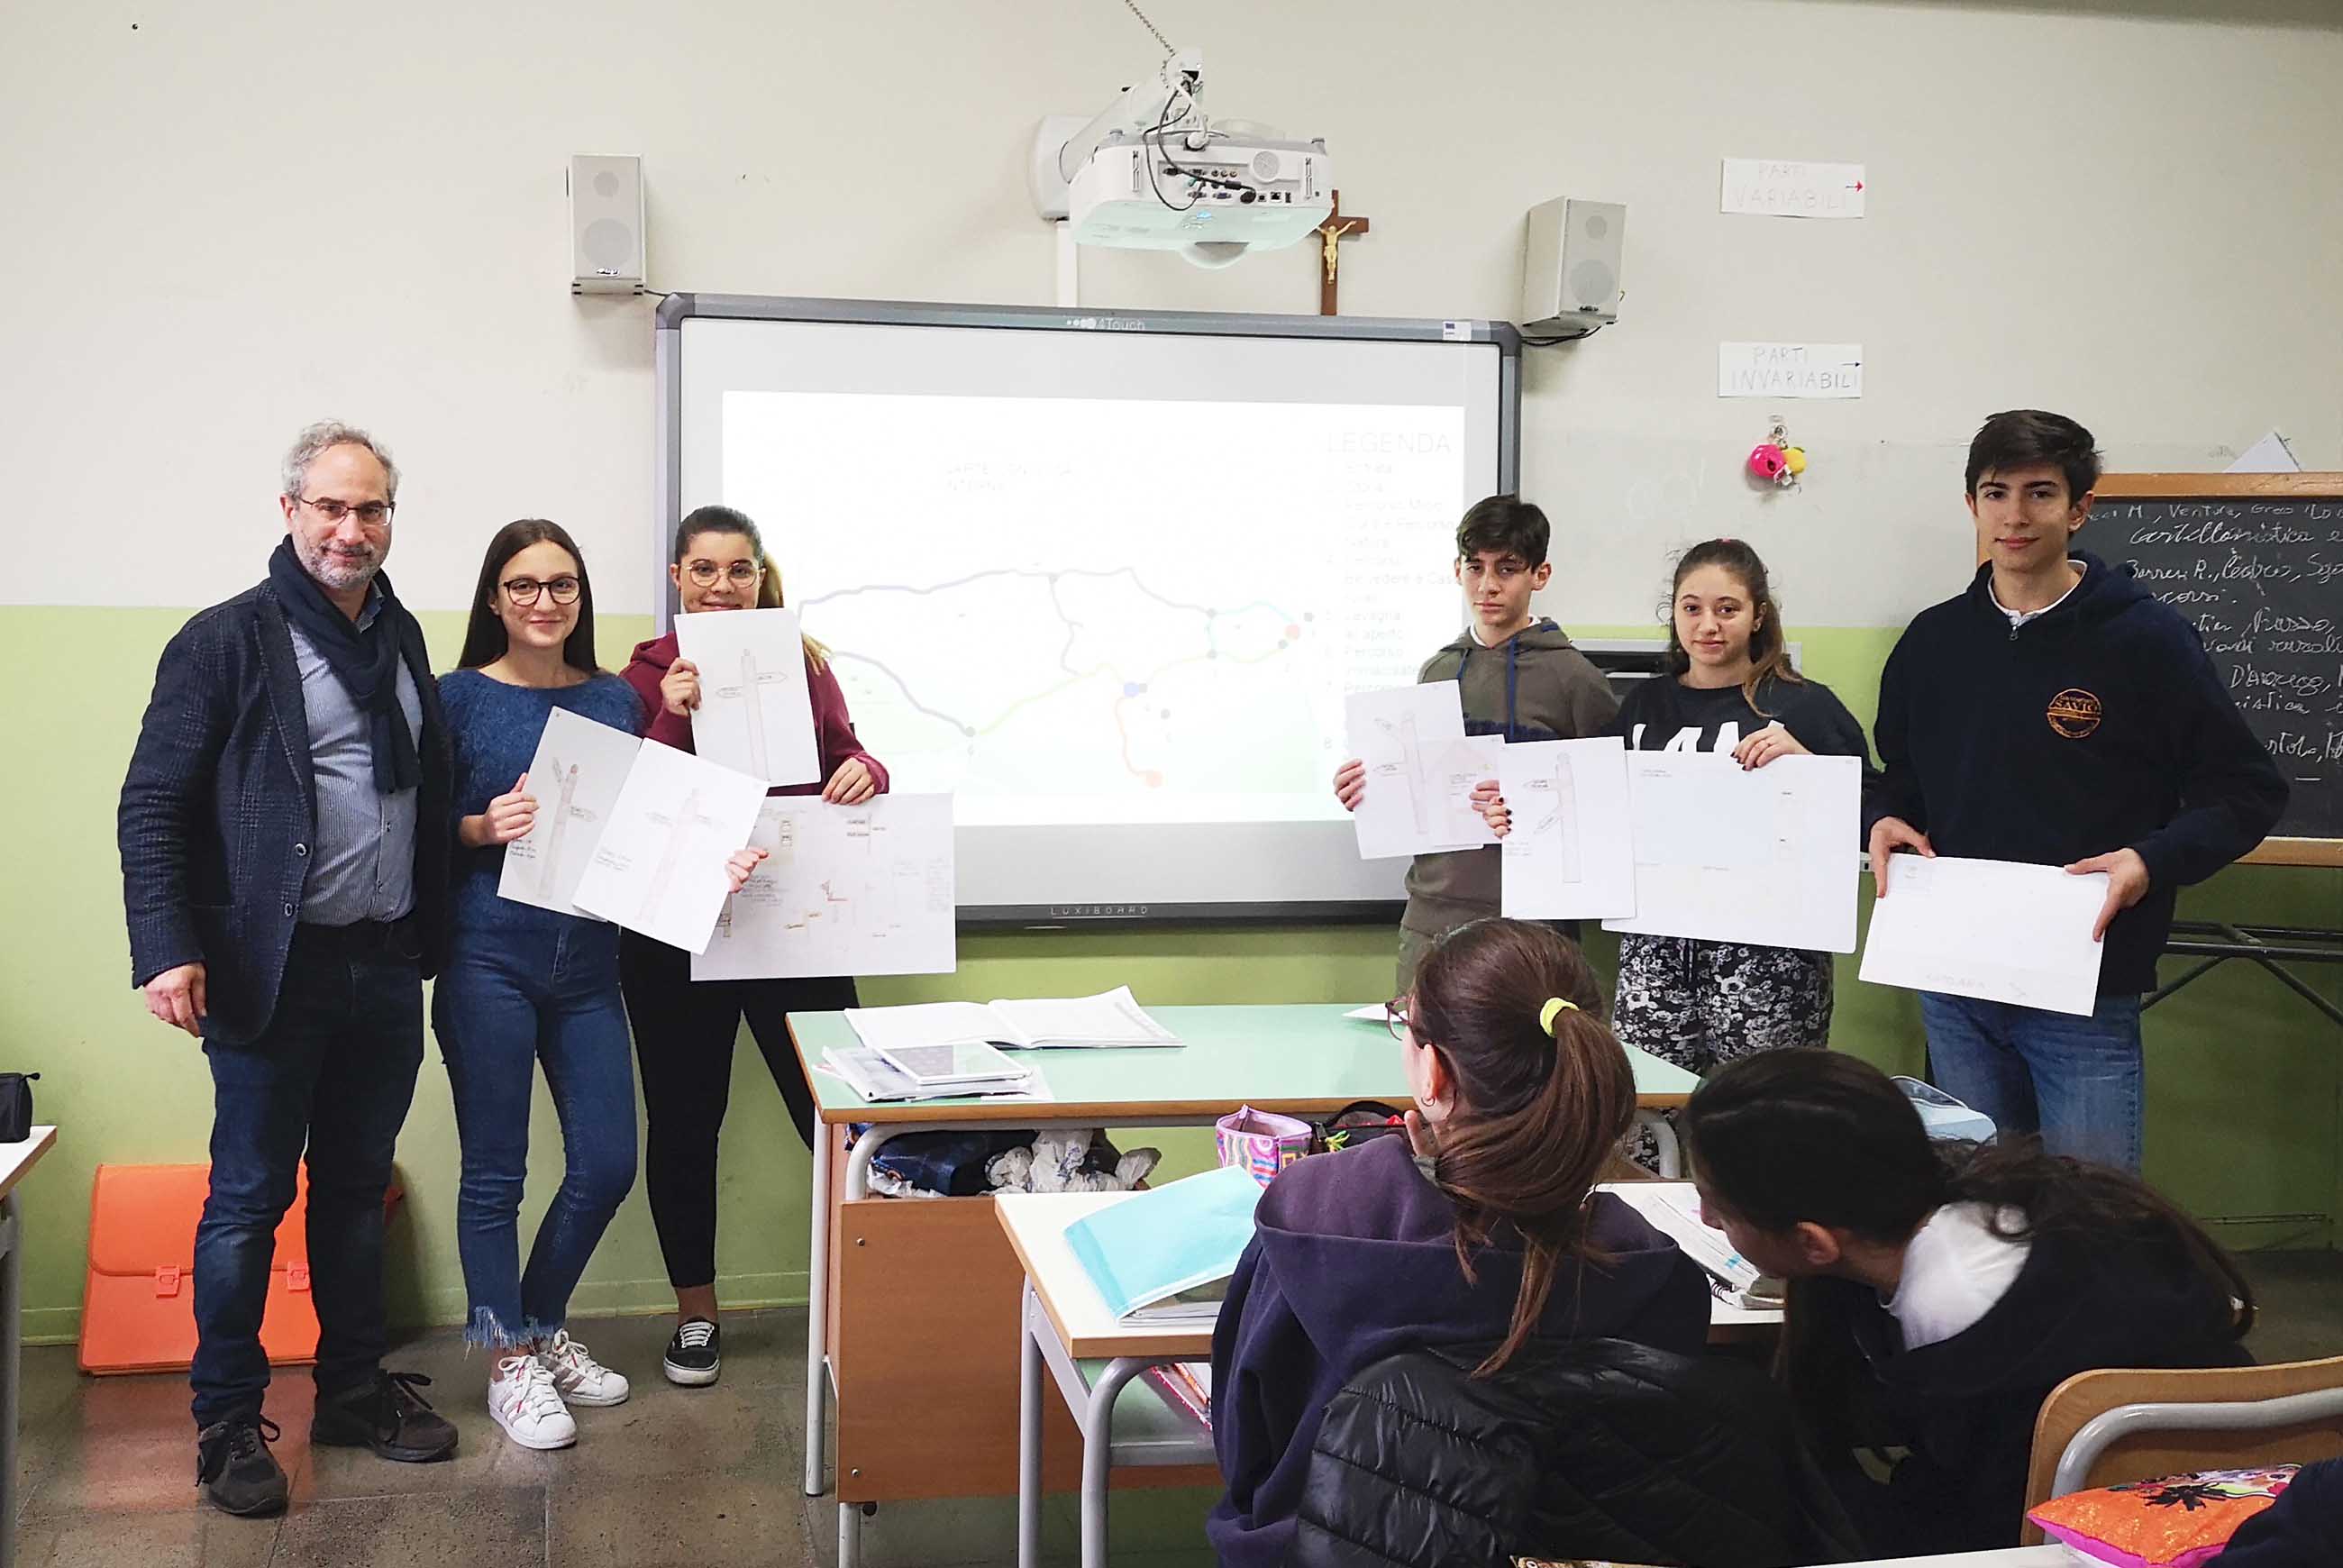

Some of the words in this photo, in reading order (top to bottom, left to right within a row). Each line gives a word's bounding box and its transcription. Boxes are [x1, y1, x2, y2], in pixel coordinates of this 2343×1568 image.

[1752, 346, 1808, 365] PARTI
[1731, 369, 1858, 389] INVARIABILI
[1327, 433, 1451, 453] LEGENDA
[1050, 907, 1148, 916] LUXIBOARD
